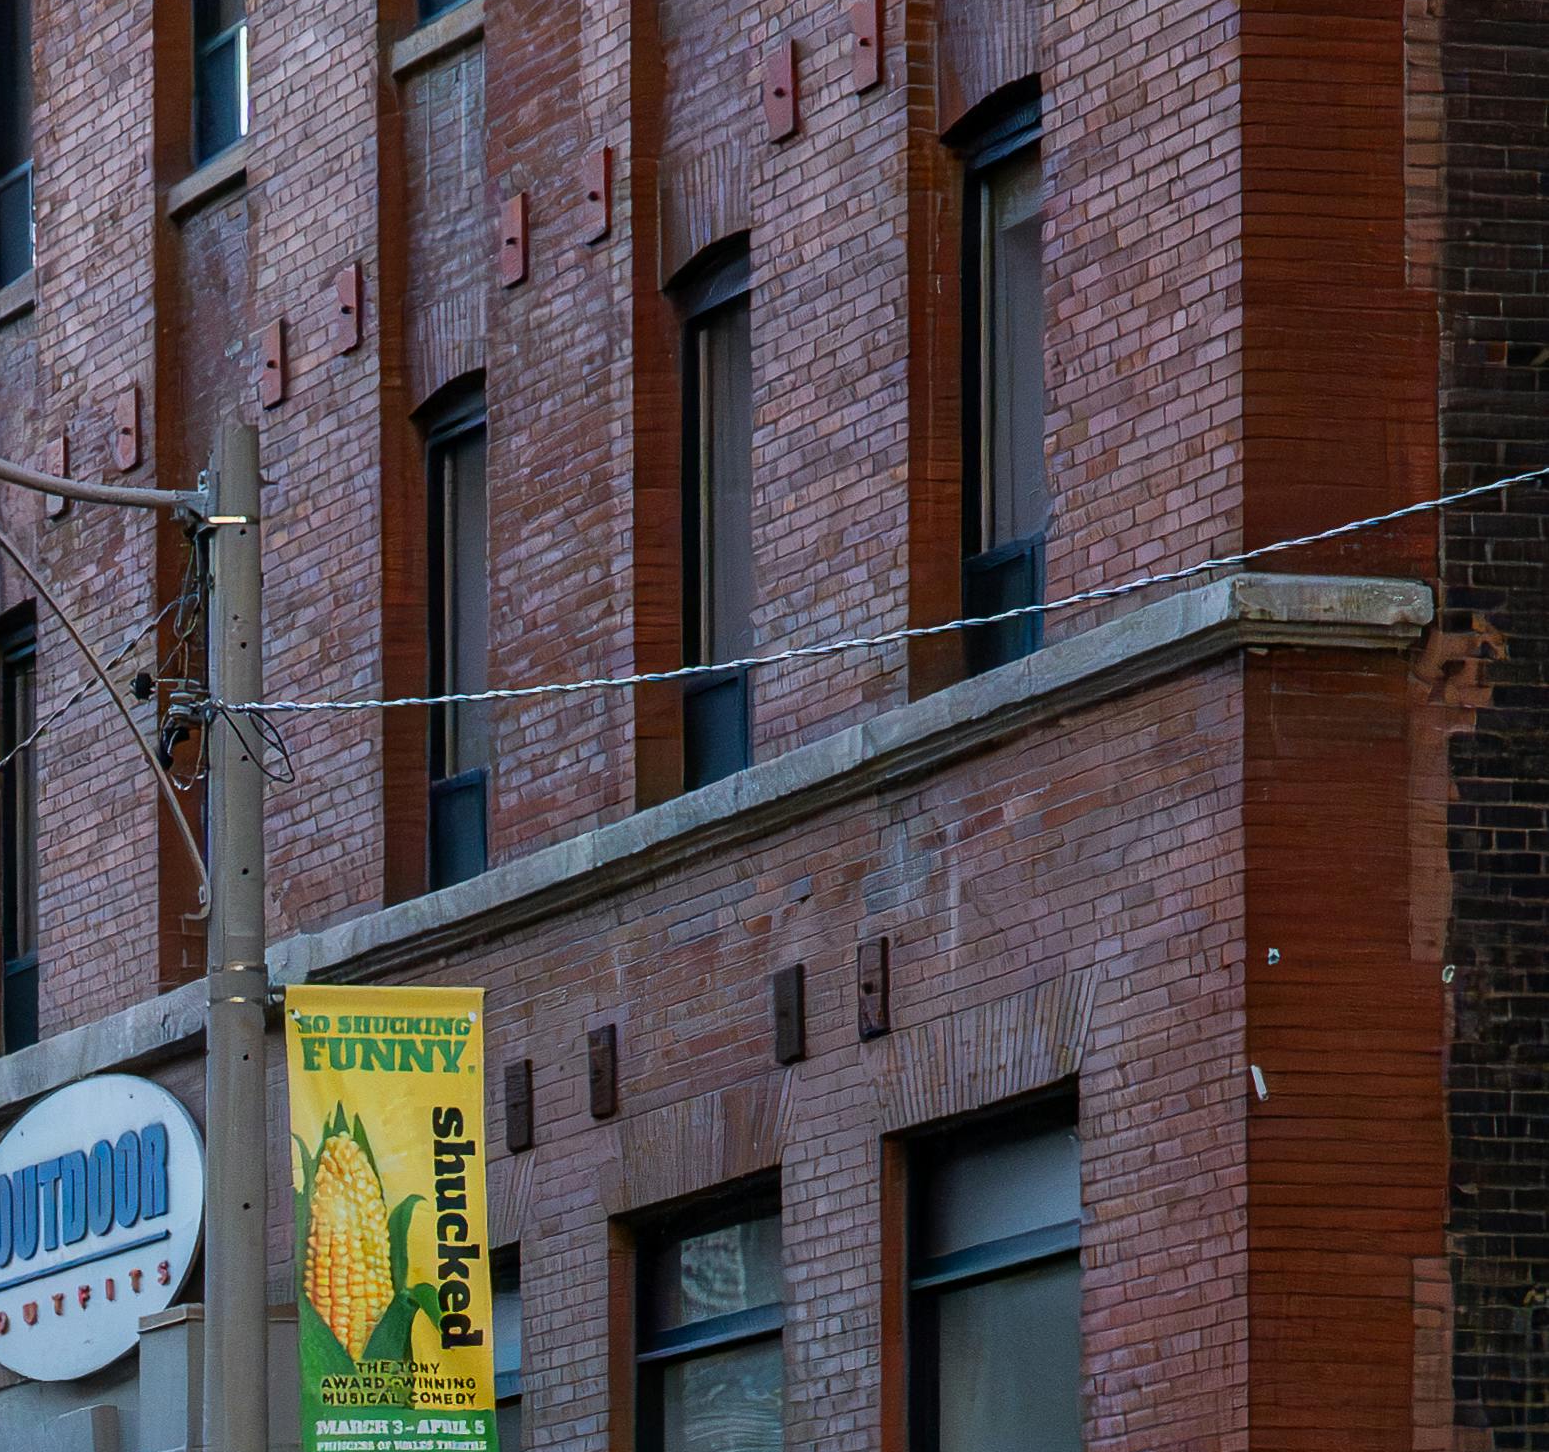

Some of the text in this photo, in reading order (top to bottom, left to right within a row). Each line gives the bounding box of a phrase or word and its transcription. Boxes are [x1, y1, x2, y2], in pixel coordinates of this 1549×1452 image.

[298, 1015, 471, 1036] SO SHUCKING
[432, 1106, 483, 1350] shucked
[356, 1362, 440, 1373] THE TONY
[322, 1392, 477, 1405] MUSICAL COMEDY
[316, 1420, 389, 1435] MARCH
[316, 1441, 375, 1452] PRINCESS
[378, 1441, 392, 1451] OF
